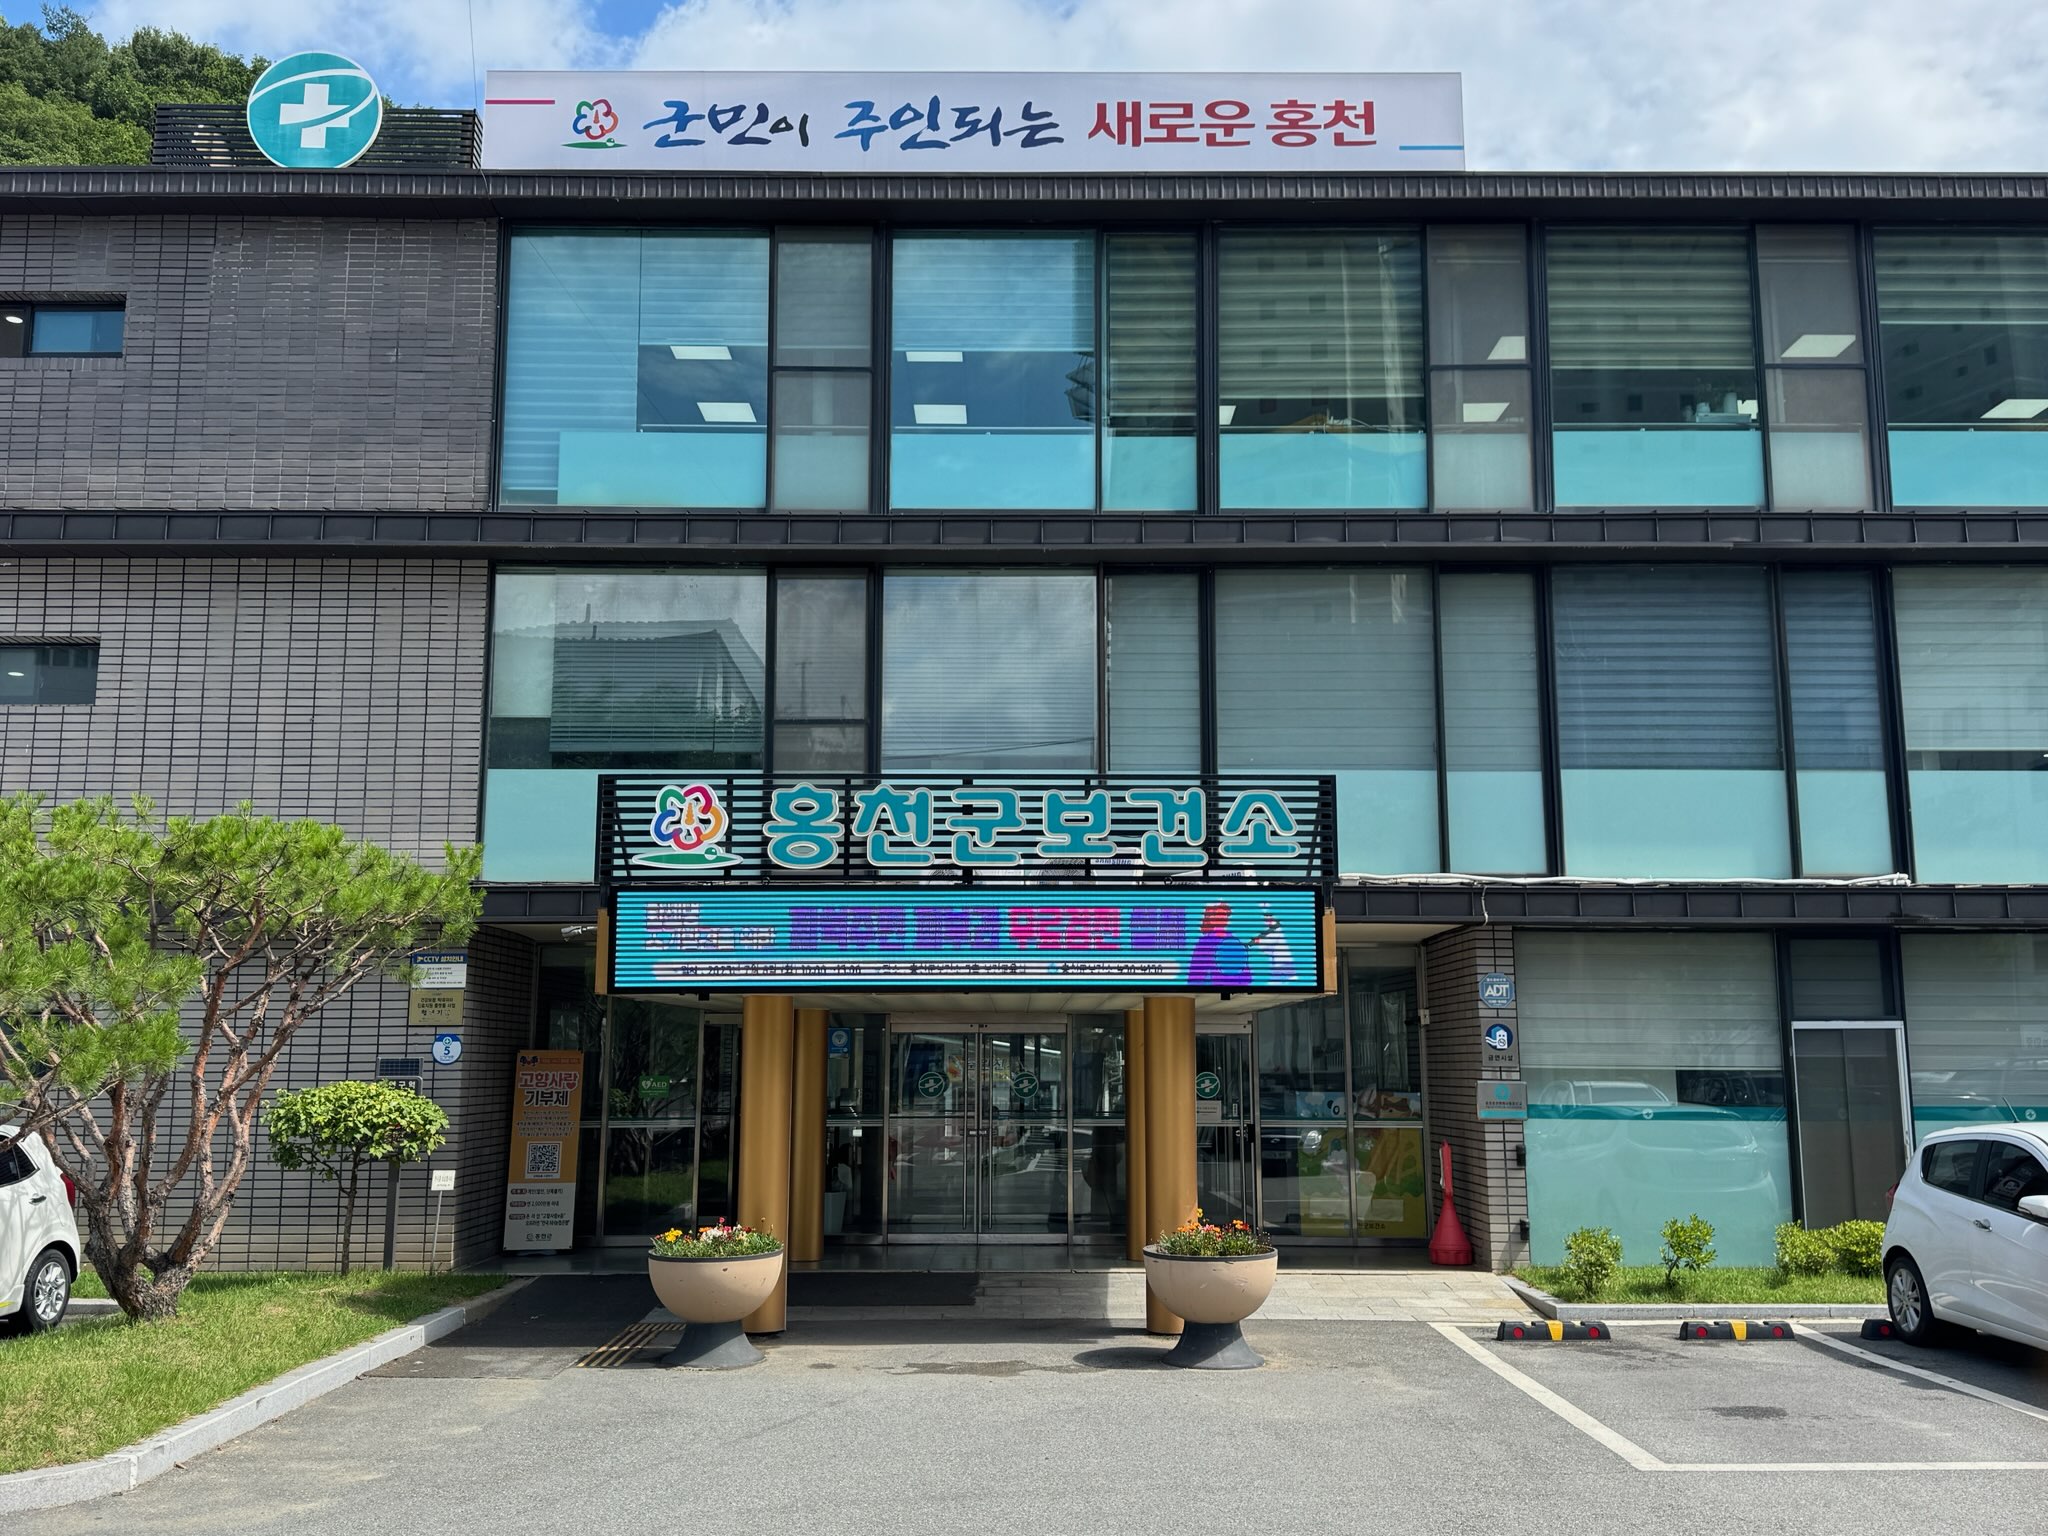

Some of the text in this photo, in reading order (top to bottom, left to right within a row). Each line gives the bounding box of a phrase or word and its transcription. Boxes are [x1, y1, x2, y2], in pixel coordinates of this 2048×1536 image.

[643, 95, 1377, 149] 군민이 주인되는 새로운 홍천
[767, 783, 1300, 869] 홍천군보건소
[1484, 984, 1509, 997] ADT
[443, 1046, 450, 1056] 5
[1488, 1054, 1513, 1062] 금연시설
[519, 1072, 578, 1090] 고향사랑
[525, 1090, 569, 1106] 기부제
